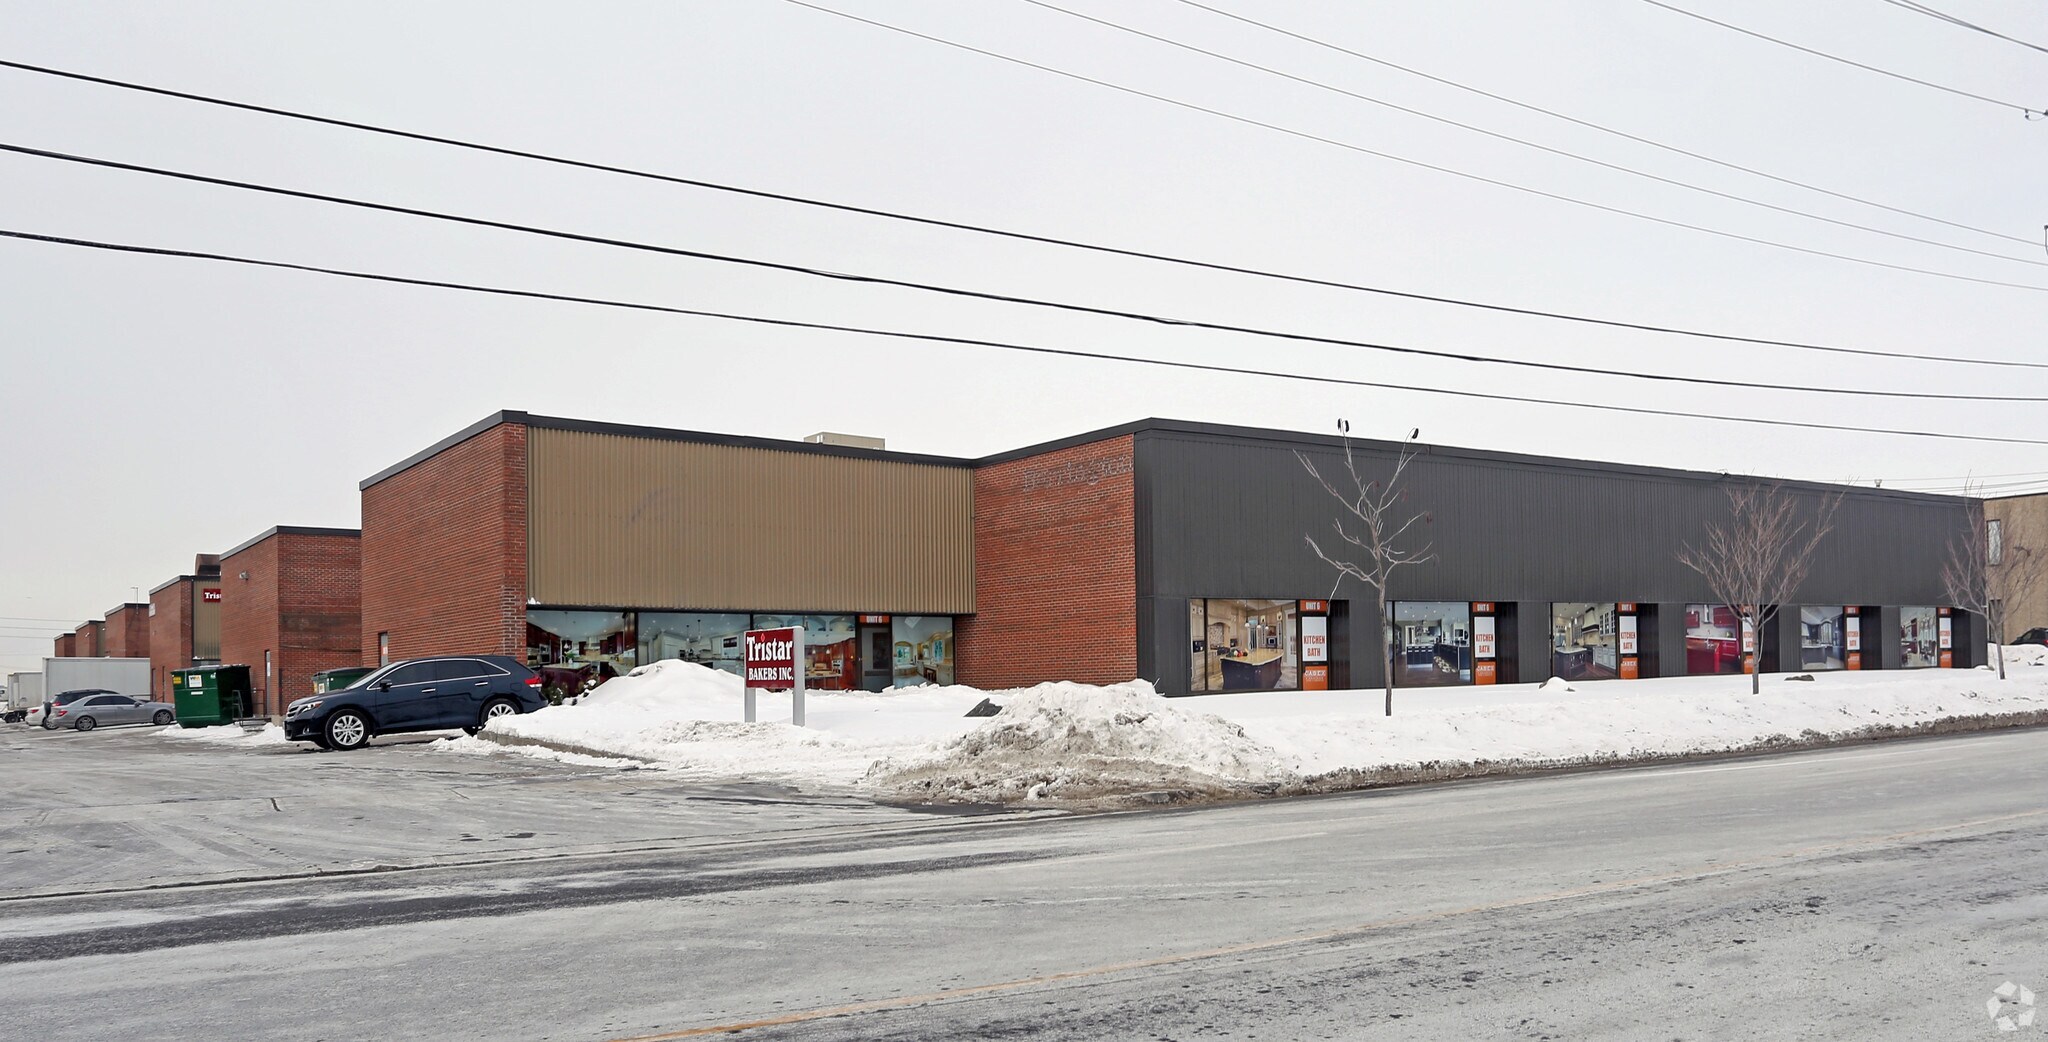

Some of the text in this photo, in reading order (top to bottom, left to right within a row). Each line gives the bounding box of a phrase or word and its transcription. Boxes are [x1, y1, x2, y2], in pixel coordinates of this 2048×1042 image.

[1303, 635, 1326, 645] KITCHEN
[1476, 633, 1493, 642] KITCHEN
[746, 634, 793, 661] Tristar
[1307, 647, 1321, 657] BATH
[748, 666, 794, 681] BAKERS INC.
